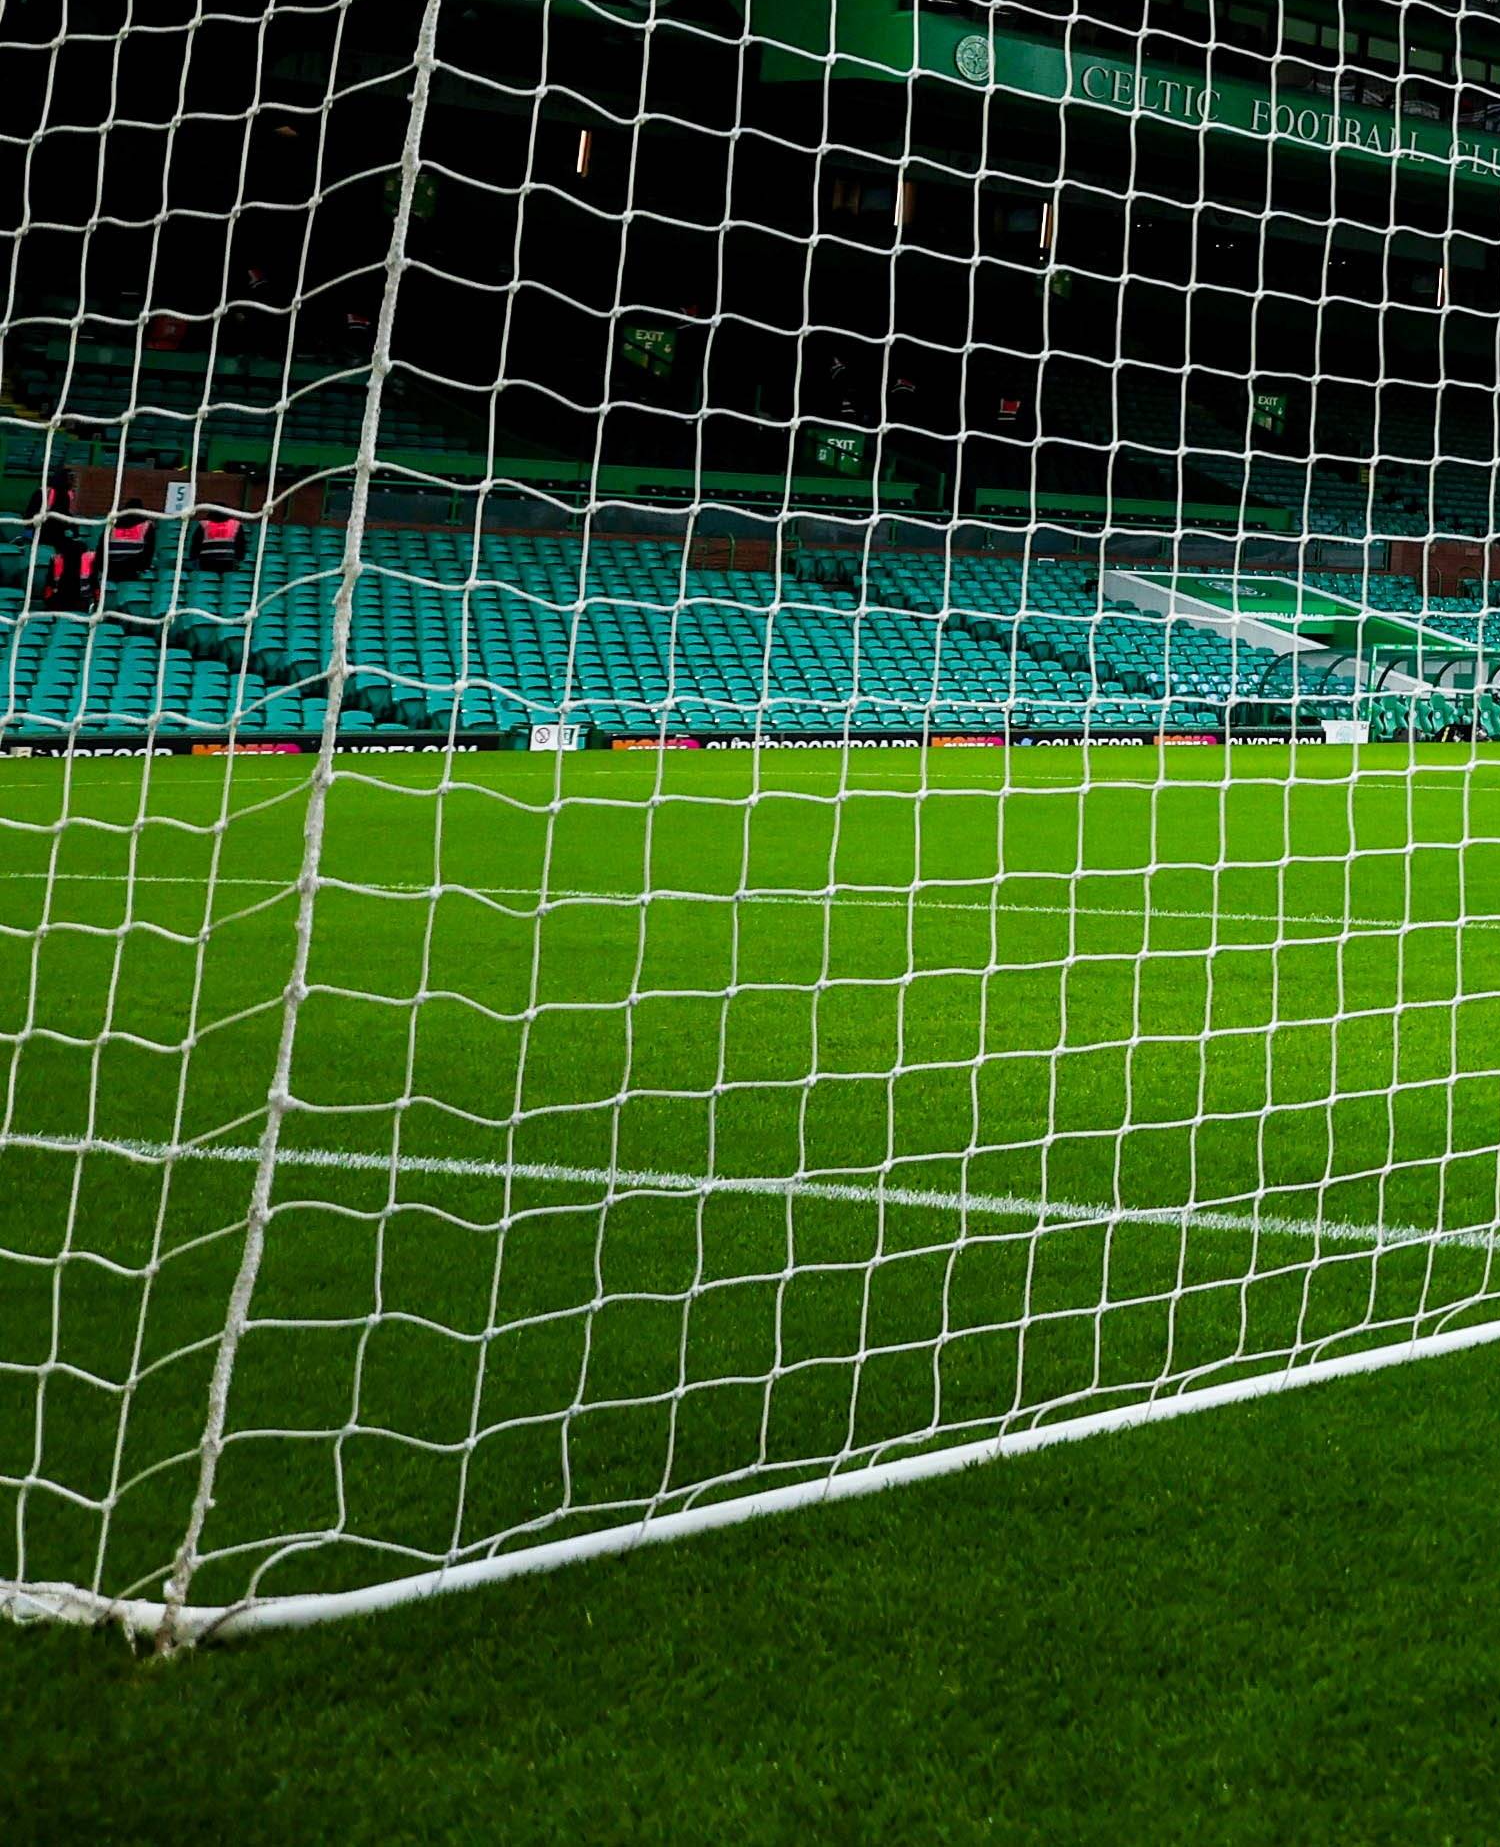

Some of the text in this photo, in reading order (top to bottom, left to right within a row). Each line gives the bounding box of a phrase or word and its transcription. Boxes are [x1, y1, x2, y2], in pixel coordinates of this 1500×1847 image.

[1082, 64, 1220, 121] CELTIC
[1250, 99, 1425, 162] FOOTBALL
[635, 330, 664, 342] EXIT
[1258, 395, 1278, 406] EXIT
[827, 438, 855, 450] EXIT
[175, 486, 185, 501] 5
